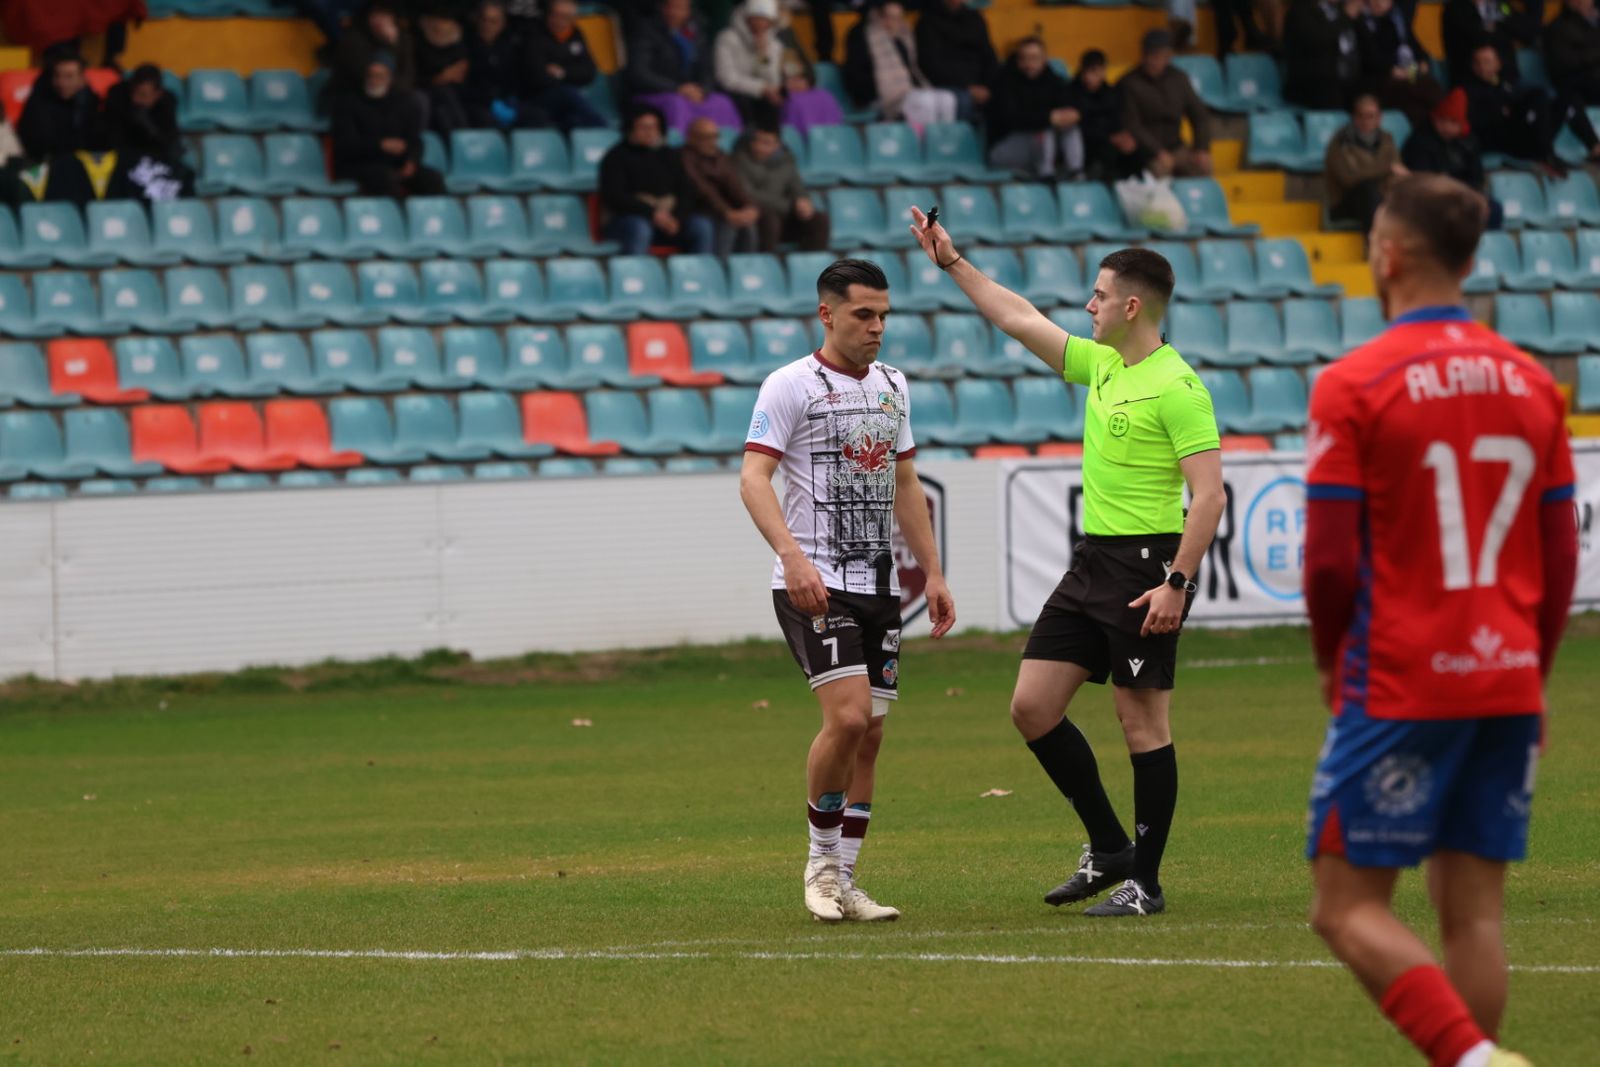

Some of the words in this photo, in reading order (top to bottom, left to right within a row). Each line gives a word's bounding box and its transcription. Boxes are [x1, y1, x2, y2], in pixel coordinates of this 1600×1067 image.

[1404, 355, 1499, 403] ALAIN
[1422, 434, 1537, 591] 17
[822, 637, 839, 665] 7
